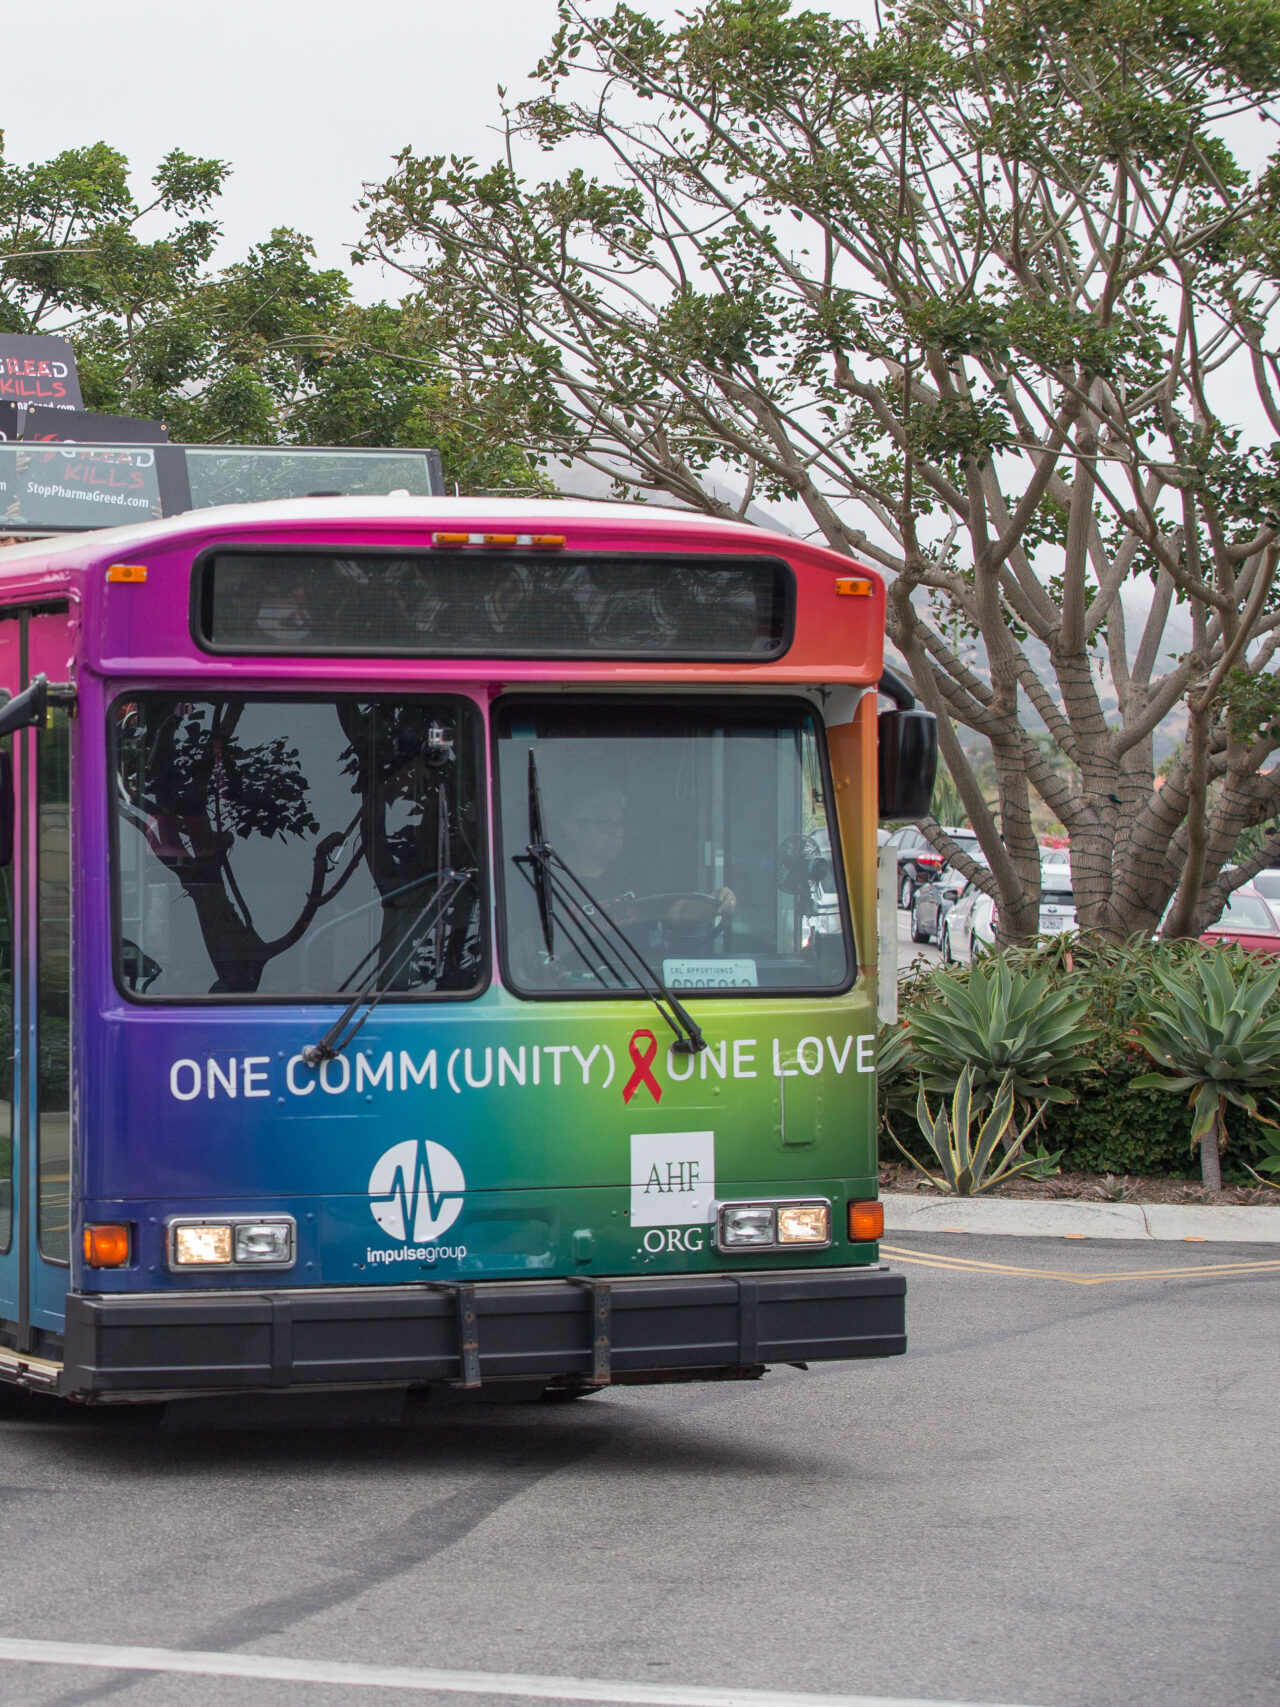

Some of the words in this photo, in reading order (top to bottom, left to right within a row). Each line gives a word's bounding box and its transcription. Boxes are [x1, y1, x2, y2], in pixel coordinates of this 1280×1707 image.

[0, 378, 66, 398] KILLS
[64, 463, 145, 489] KILLS
[27, 481, 149, 508] StopPharmaGreed.com
[170, 1056, 271, 1100] ONE
[286, 1044, 616, 1096] COMM(UNITY)
[666, 1040, 758, 1081] ONE
[773, 1034, 876, 1077] LOVE
[643, 1161, 700, 1194] AHF
[636, 1227, 703, 1254] .ORG
[367, 1245, 468, 1264] impulsegroup
